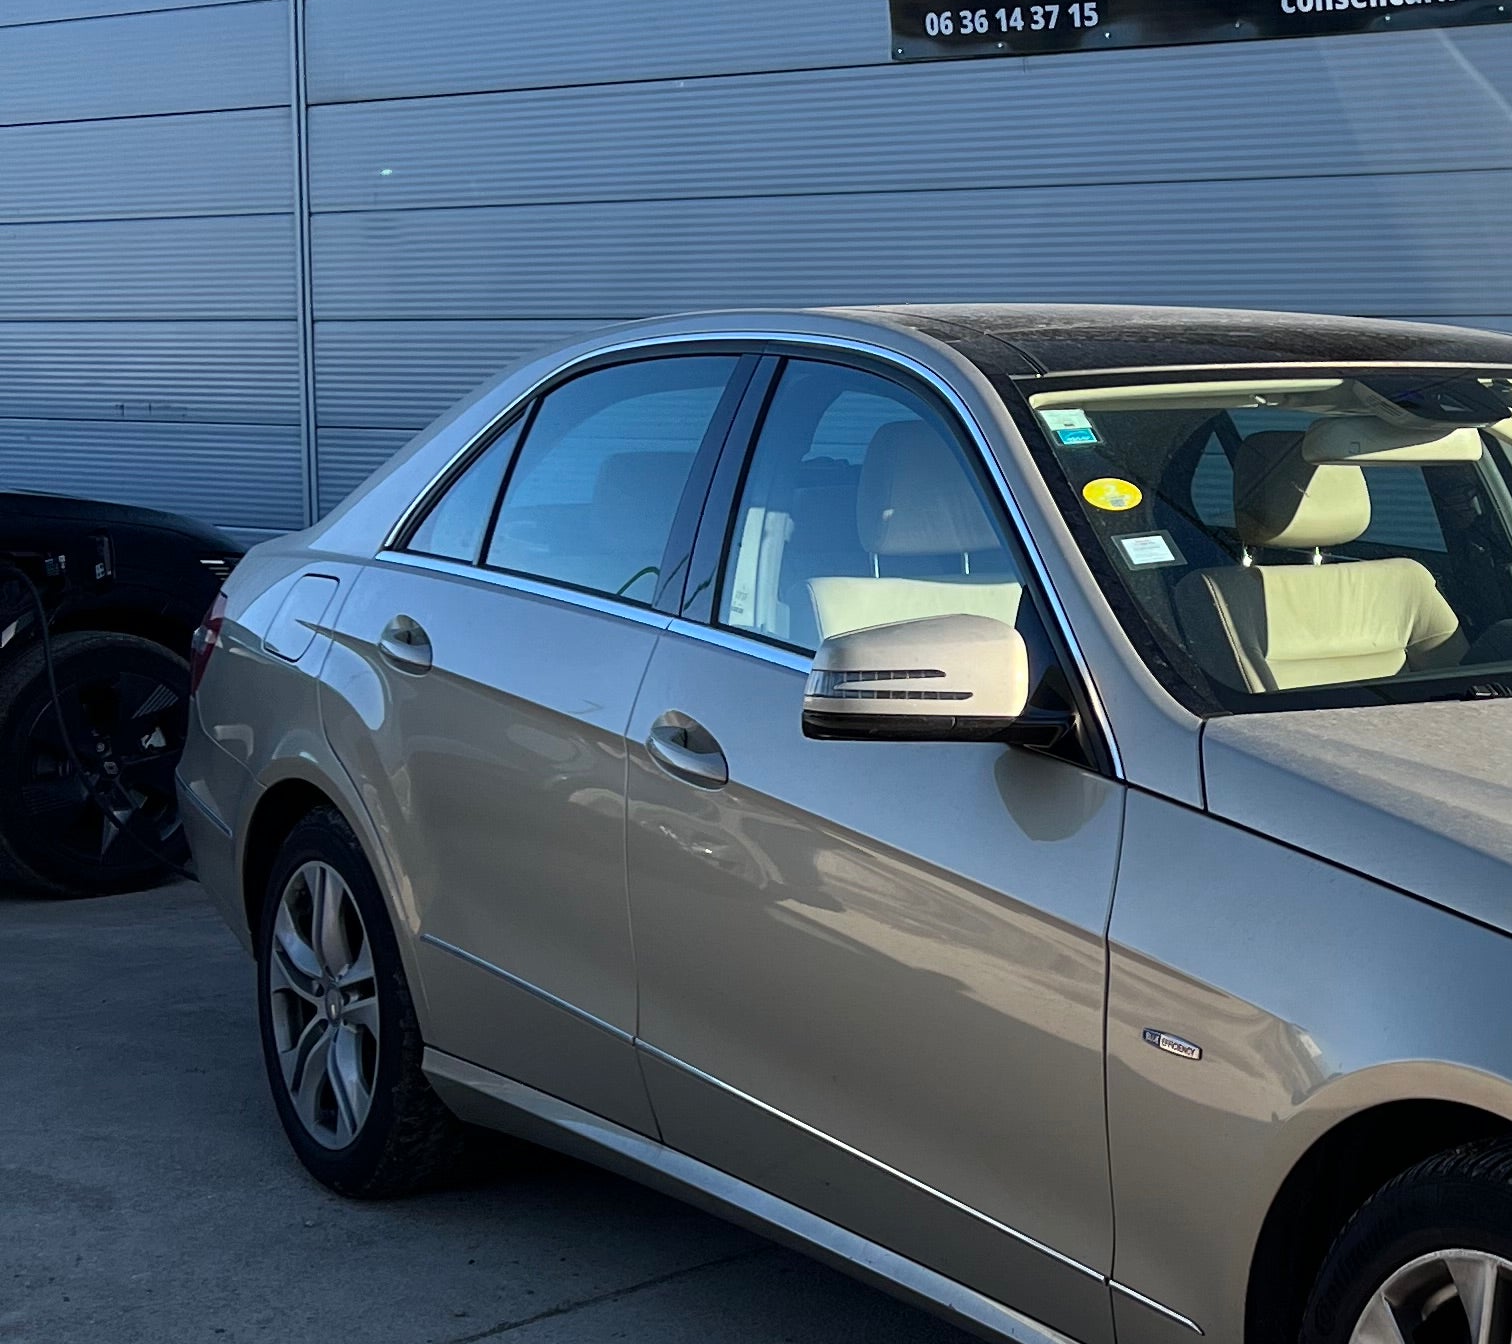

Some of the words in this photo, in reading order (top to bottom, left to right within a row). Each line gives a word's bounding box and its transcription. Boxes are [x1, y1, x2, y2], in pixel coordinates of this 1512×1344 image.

[925, 12, 953, 36] 06
[959, 10, 989, 34] 36
[995, 8, 1025, 32] 14
[1030, 5, 1059, 30] 37
[1068, 2, 1098, 27] 15
